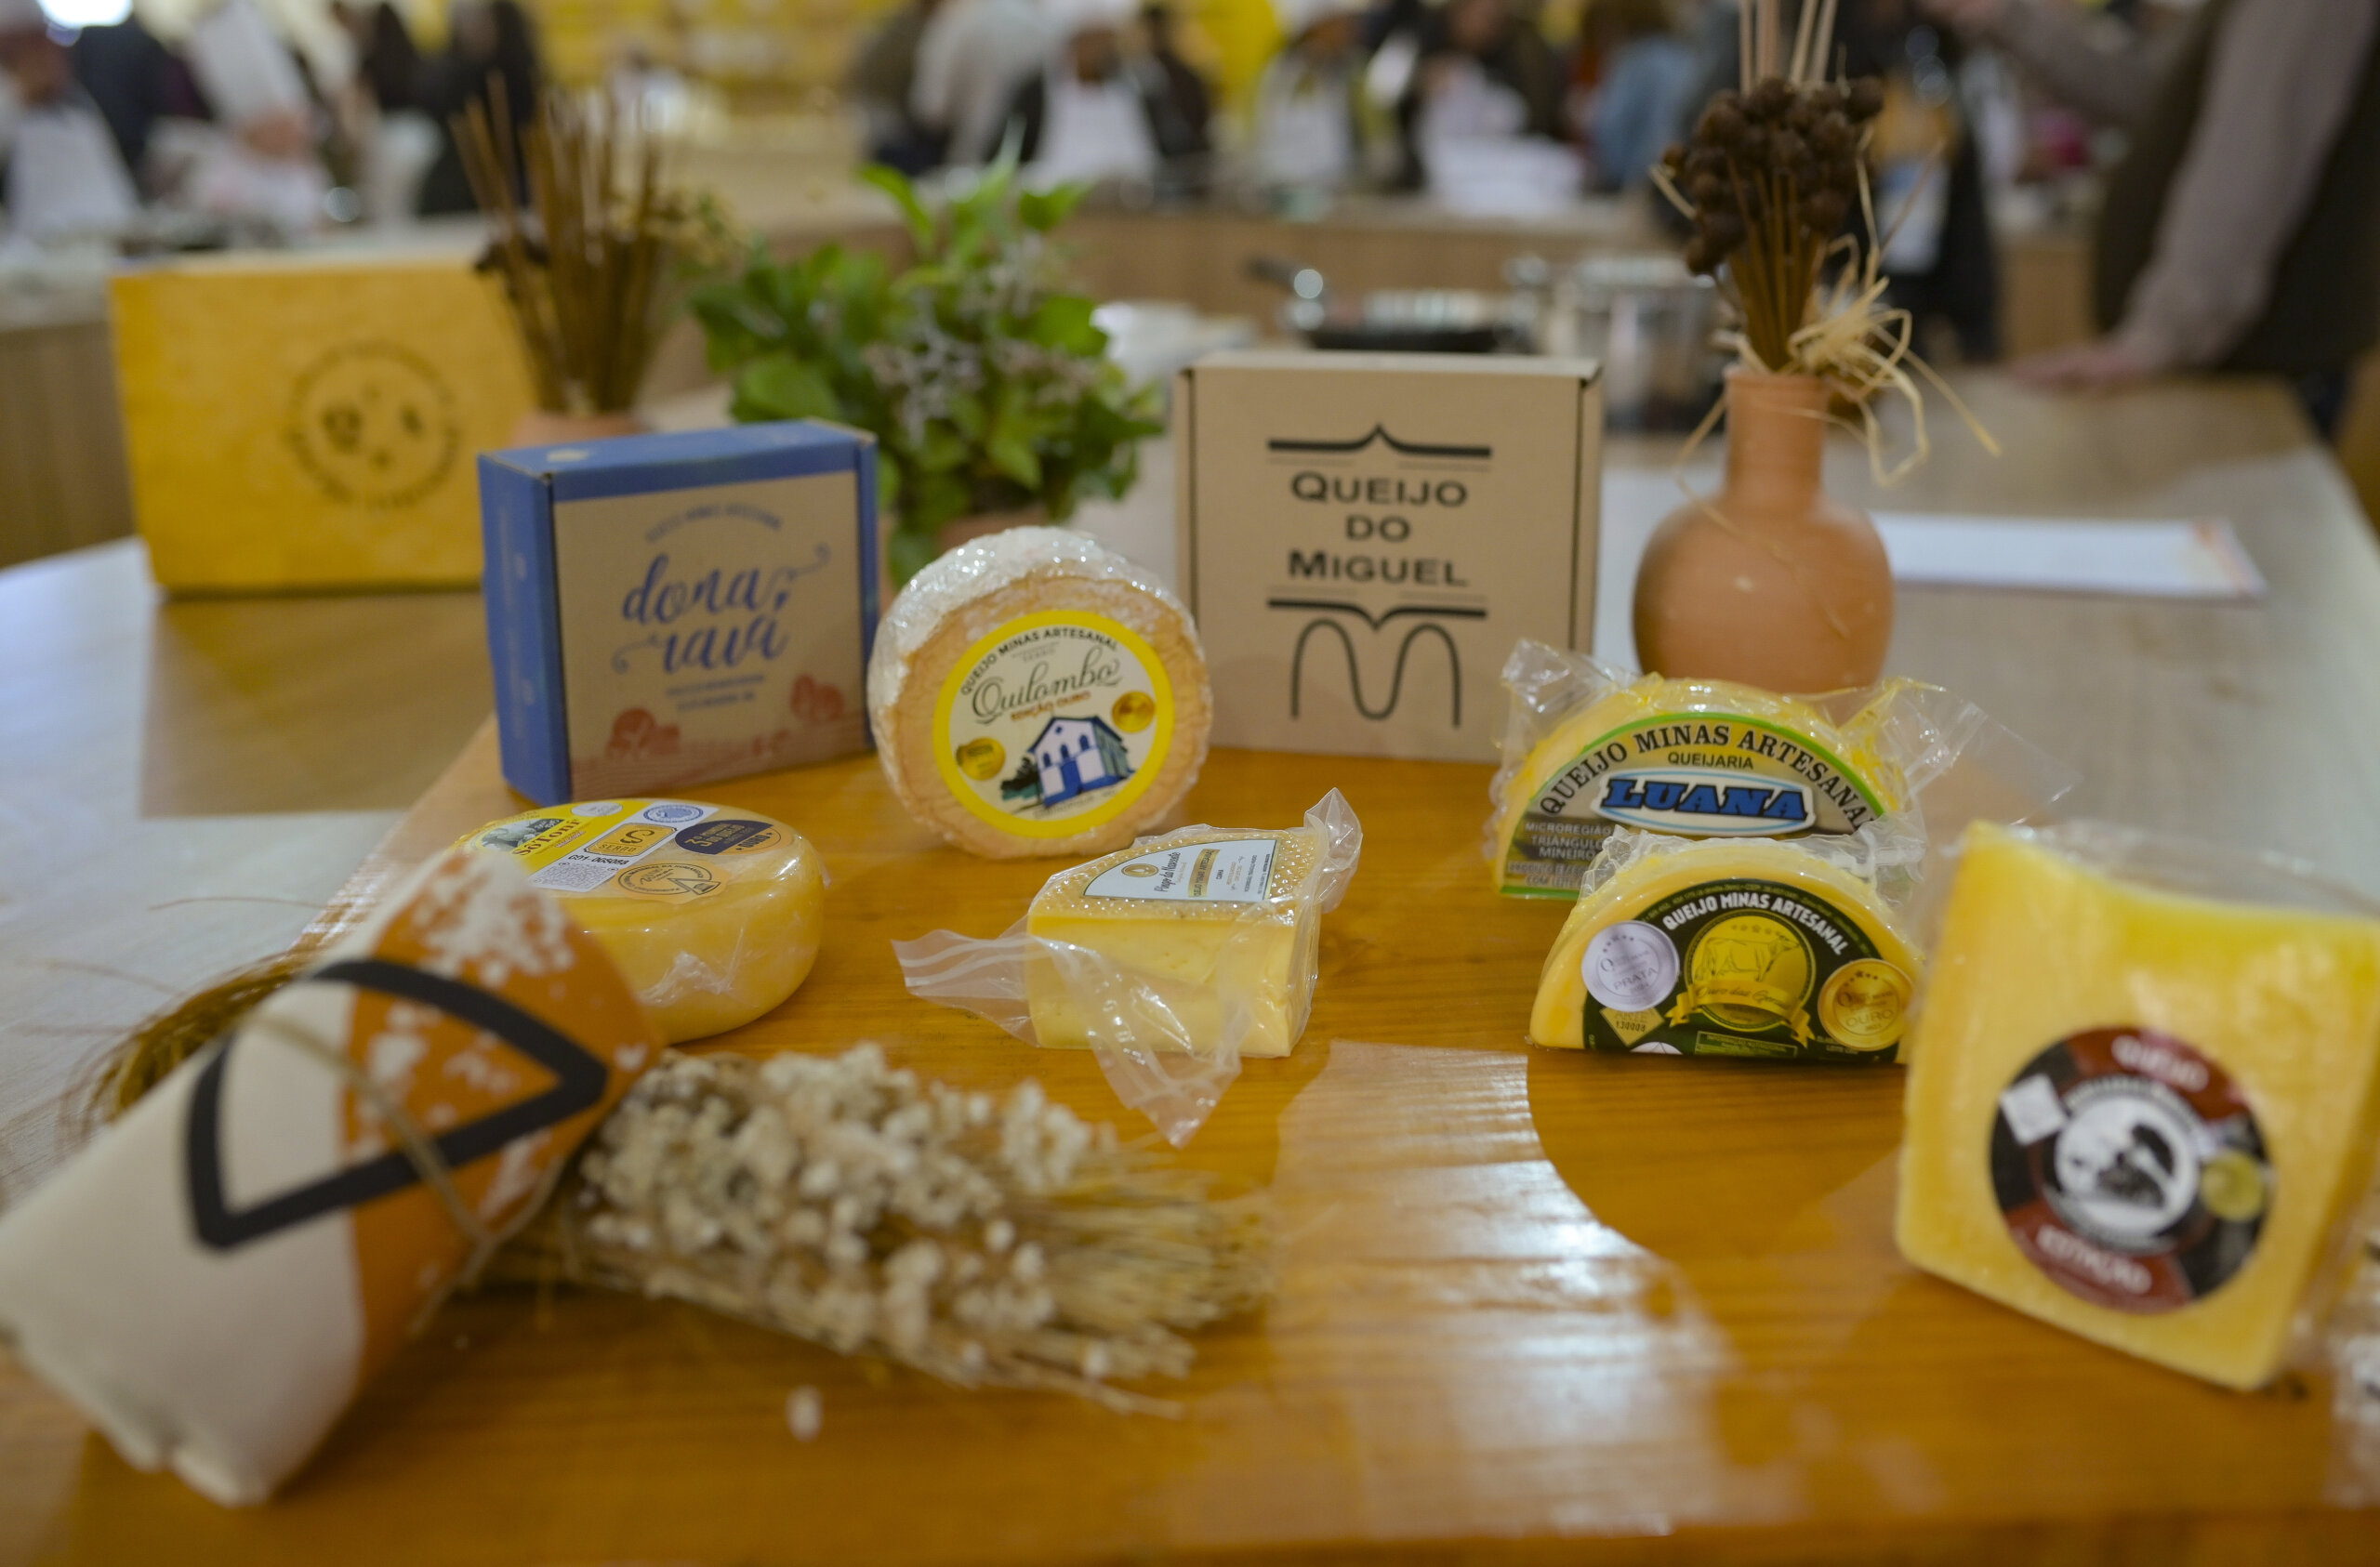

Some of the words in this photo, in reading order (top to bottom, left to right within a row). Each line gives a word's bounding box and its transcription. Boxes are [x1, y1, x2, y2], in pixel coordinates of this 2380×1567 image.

[1289, 470, 1469, 508] QUEIJO
[1345, 515, 1411, 543] DO
[622, 552, 768, 625] dona
[1288, 549, 1469, 587] MIGUEL
[960, 652, 998, 696] QUEIJO
[998, 632, 1039, 655] MINAS
[1043, 627, 1118, 652] ARTESANAL
[972, 645, 1123, 725] Quilombo
[1540, 742, 1627, 814] QUEIJO
[1633, 724, 1729, 754] MINAS
[1737, 730, 1875, 832] ARTESANA
[1667, 751, 1754, 770] QUEIJARIA
[1599, 778, 1808, 822] LUANA
[1662, 895, 1719, 931] QUEIJO
[1720, 891, 1770, 910] MINAS
[1770, 896, 1850, 956] ARTESANAL
[1613, 967, 1659, 991] PRATA
[1844, 1008, 1894, 1027] OURO
